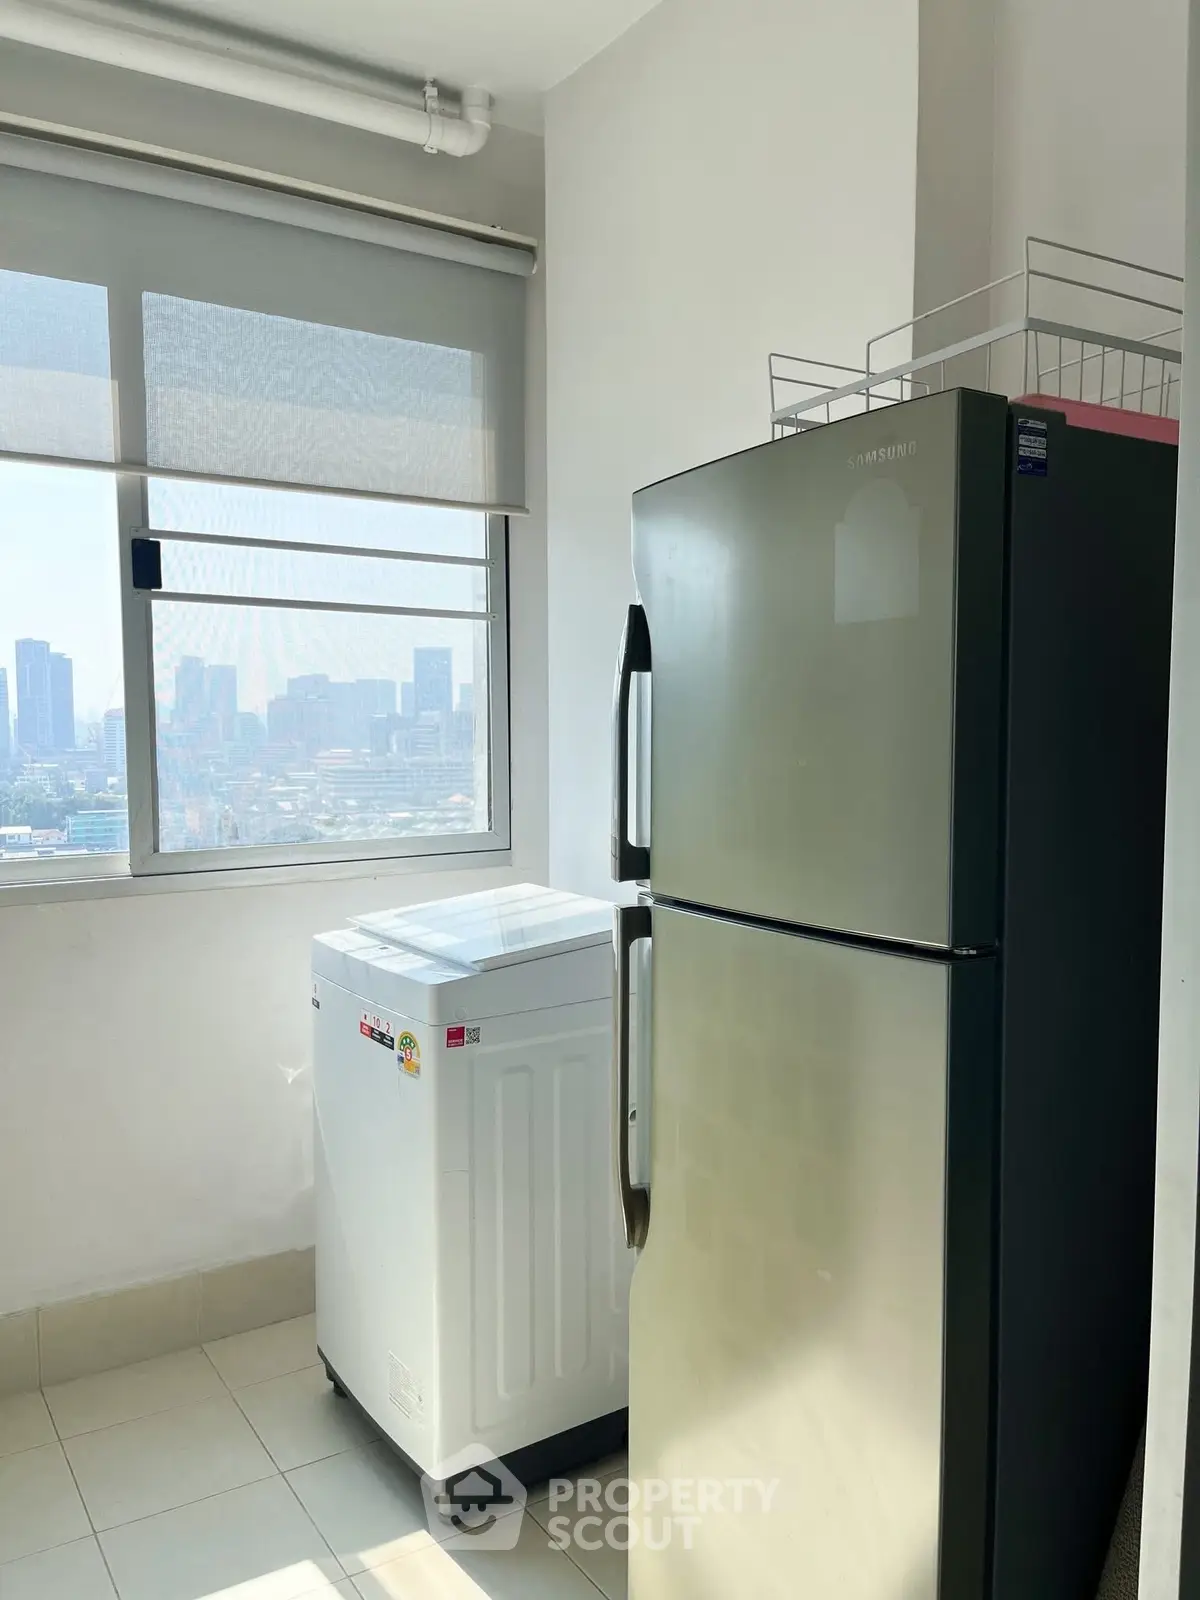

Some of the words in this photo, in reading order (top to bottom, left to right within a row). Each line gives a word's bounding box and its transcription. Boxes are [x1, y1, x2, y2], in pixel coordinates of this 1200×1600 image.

[847, 440, 917, 470] SAMSUNG
[373, 1016, 381, 1028] 10
[386, 1022, 391, 1034] 2
[405, 1047, 411, 1059] 5
